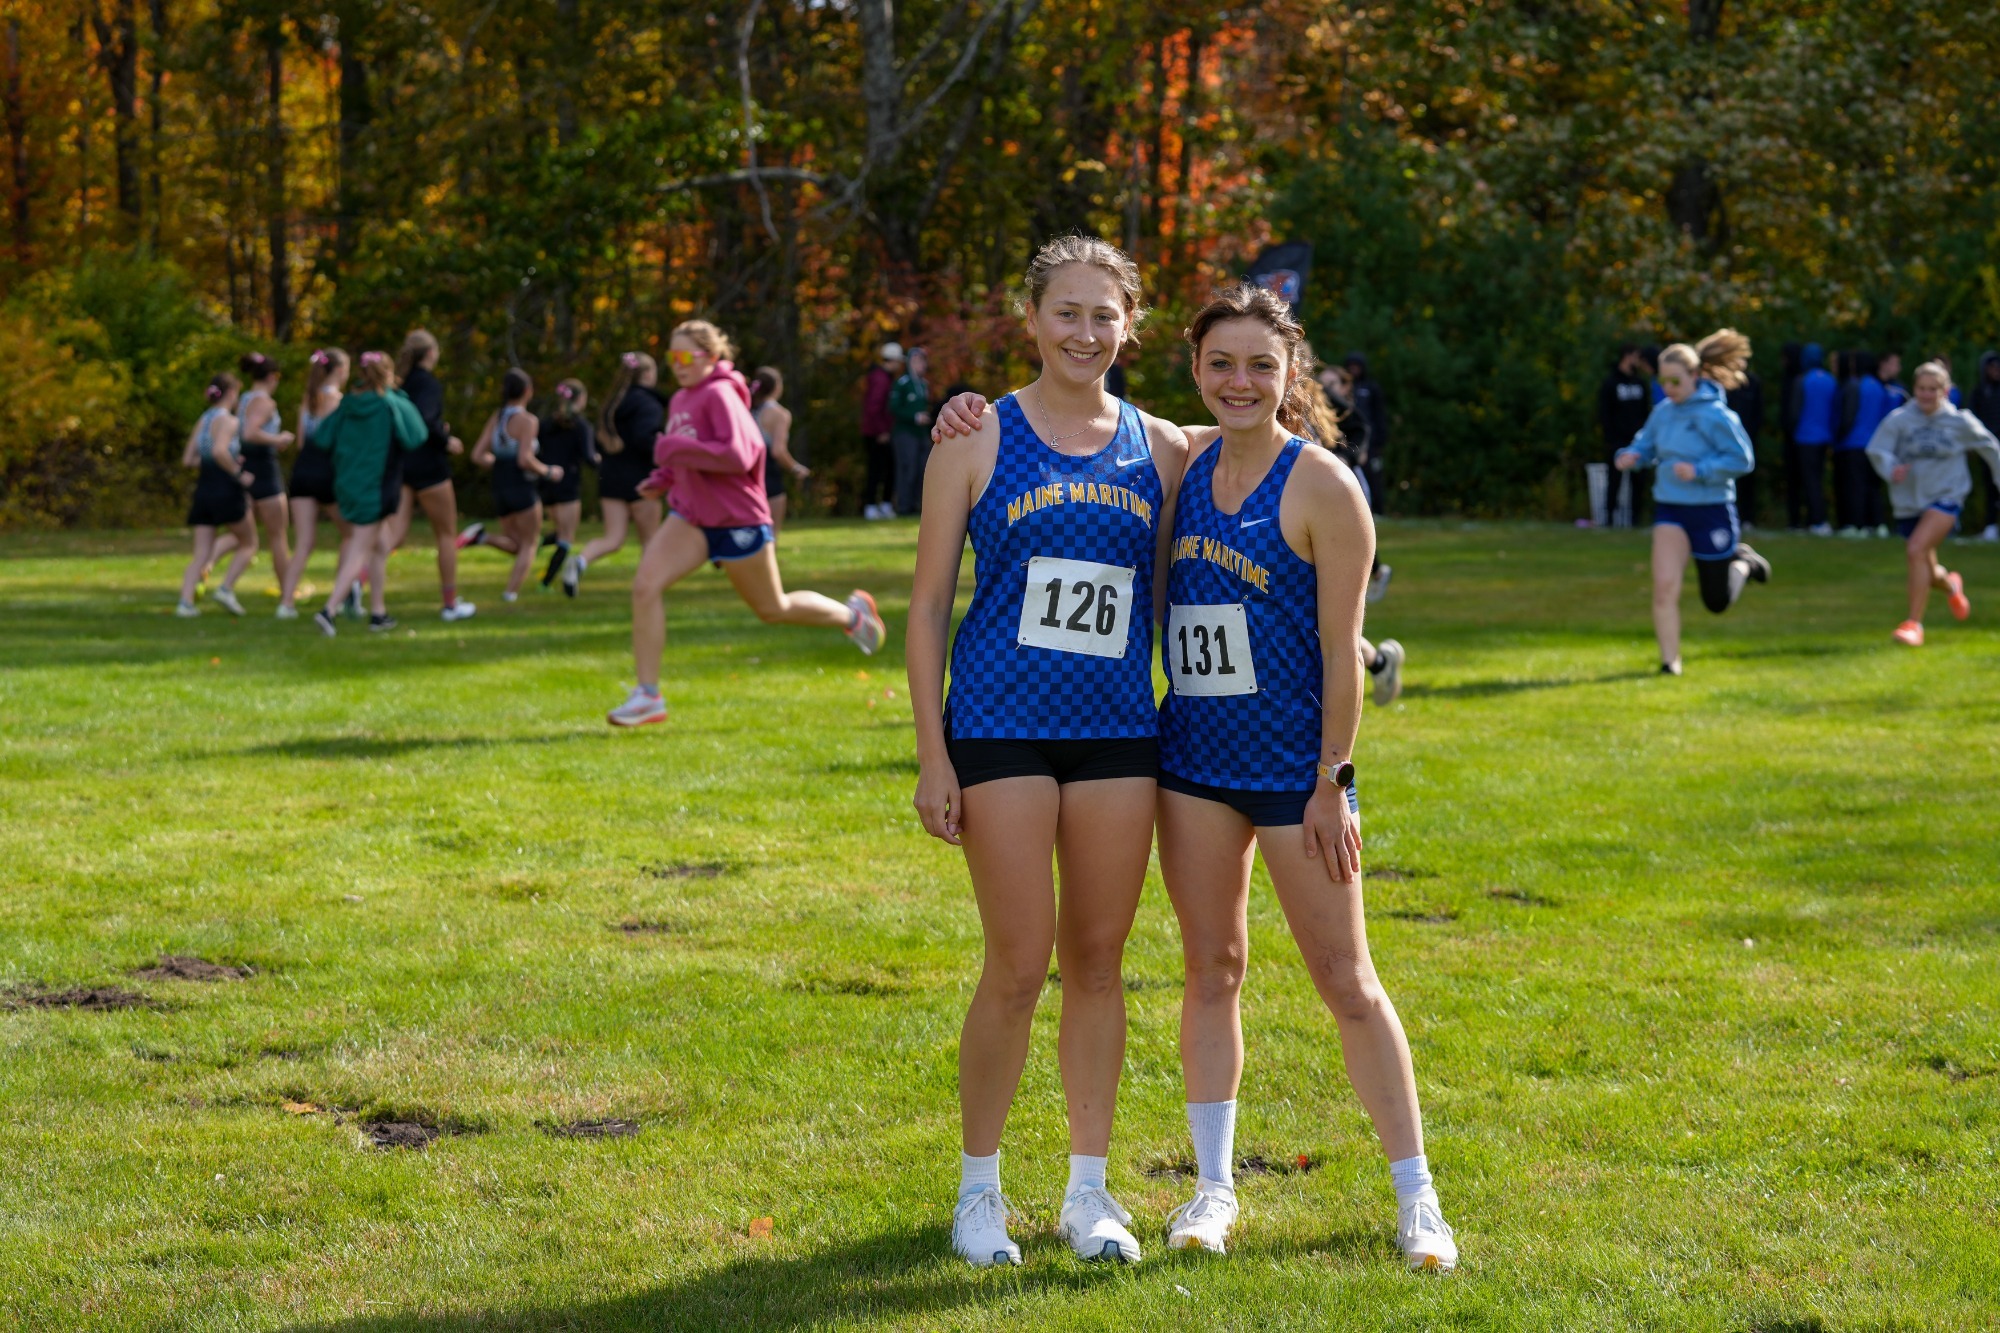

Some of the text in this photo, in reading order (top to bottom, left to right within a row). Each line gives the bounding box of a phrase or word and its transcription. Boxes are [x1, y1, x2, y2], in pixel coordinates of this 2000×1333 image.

[1007, 482, 1152, 529] MAINE MARITIME
[1203, 536, 1270, 594] MARITIME
[1040, 577, 1118, 636] 126
[1178, 624, 1236, 676] 131
